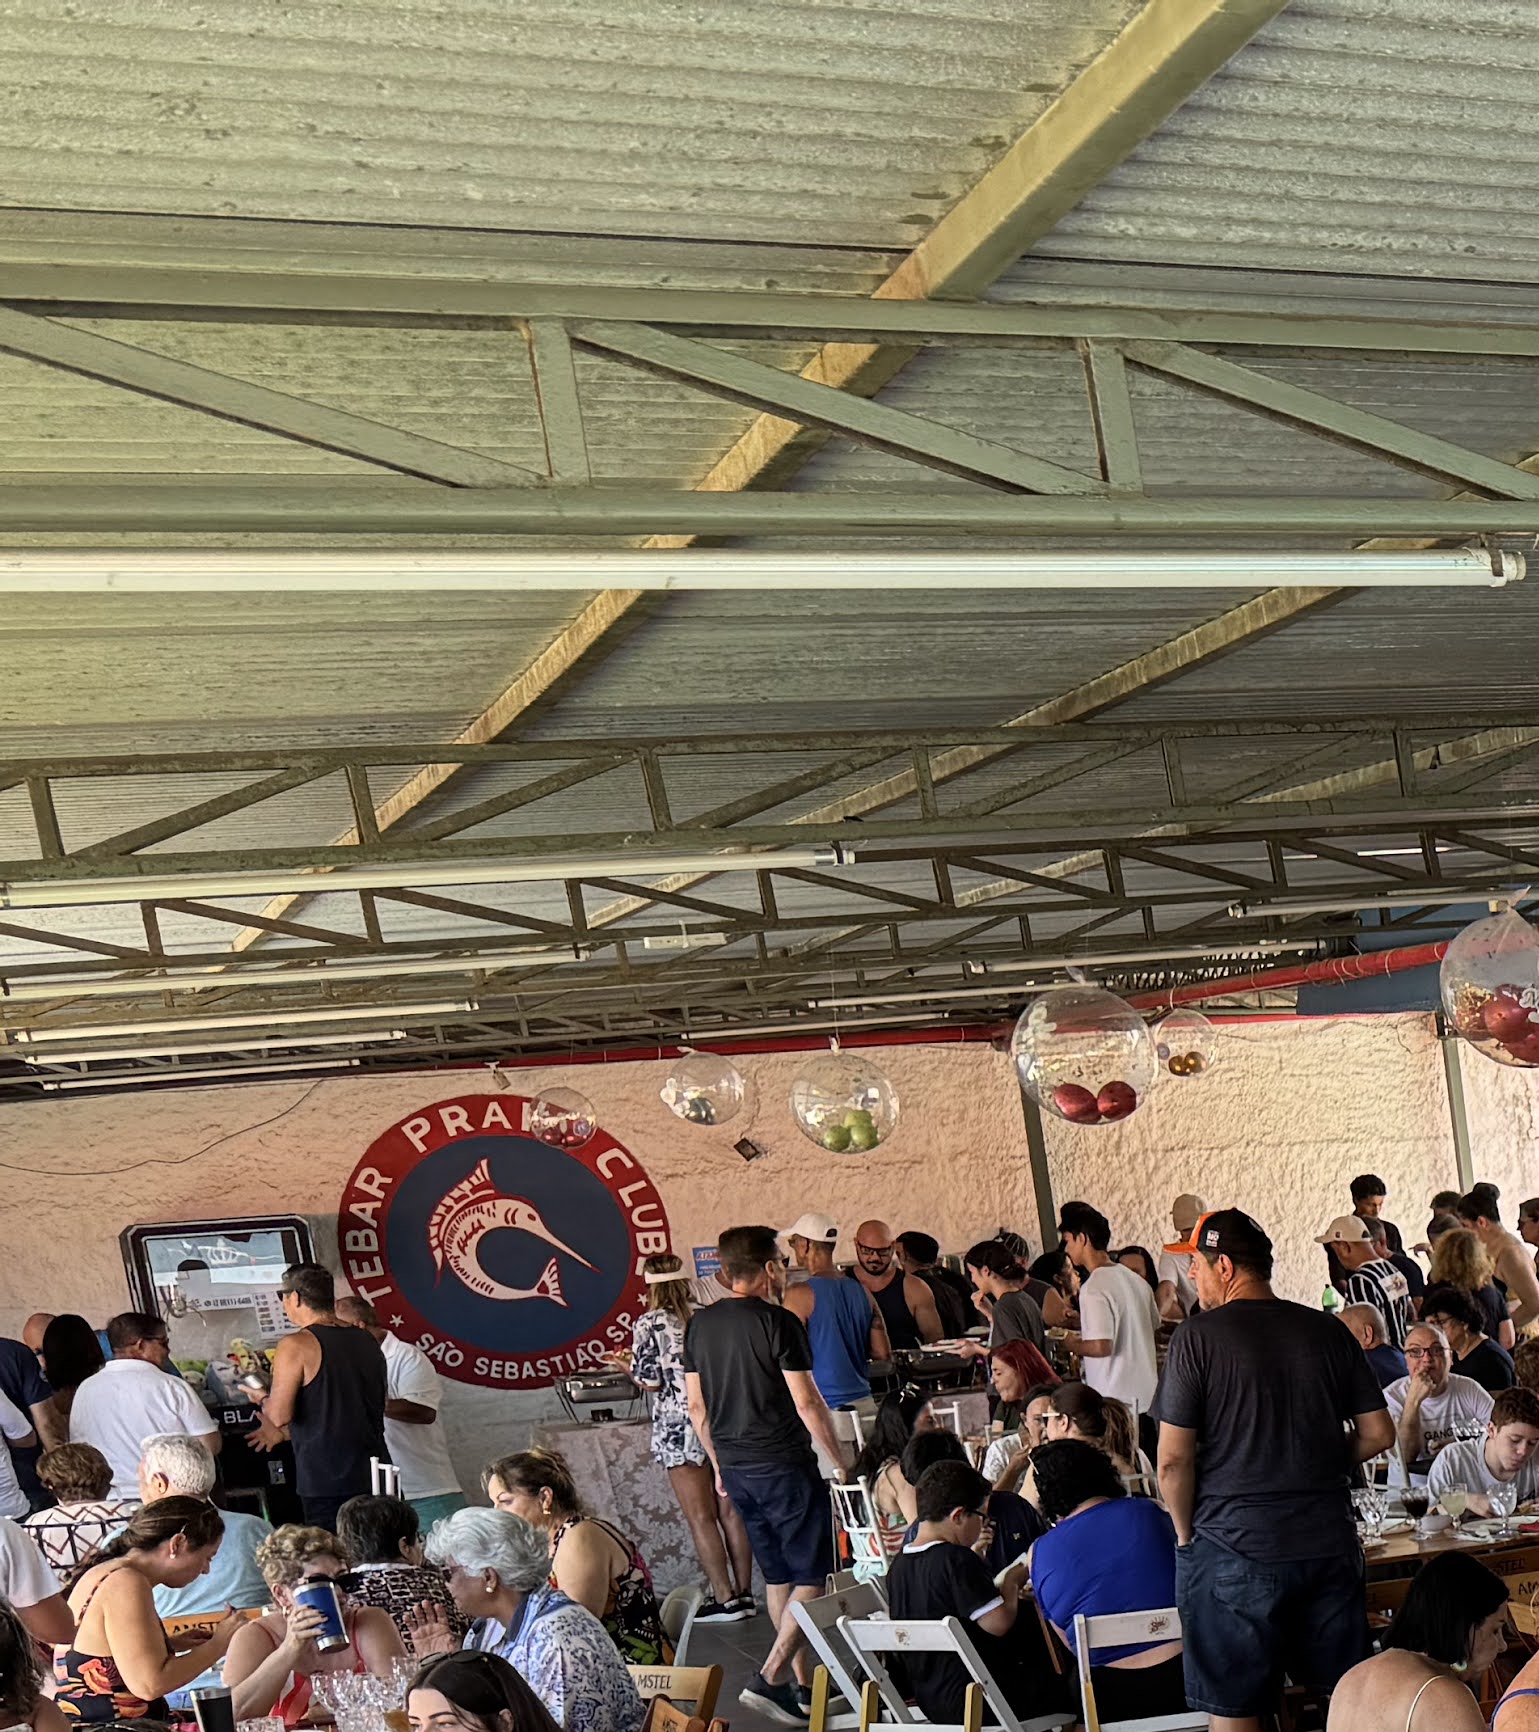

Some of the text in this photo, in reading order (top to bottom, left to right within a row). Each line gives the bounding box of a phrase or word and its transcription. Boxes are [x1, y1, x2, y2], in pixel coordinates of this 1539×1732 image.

[401, 1100, 532, 1154] PRAI
[345, 1166, 393, 1307] TEBAR
[415, 1332, 464, 1368] SÃO
[473, 1338, 606, 1380] SEBASTIÃO
[637, 1674, 672, 1690] MSTEL
